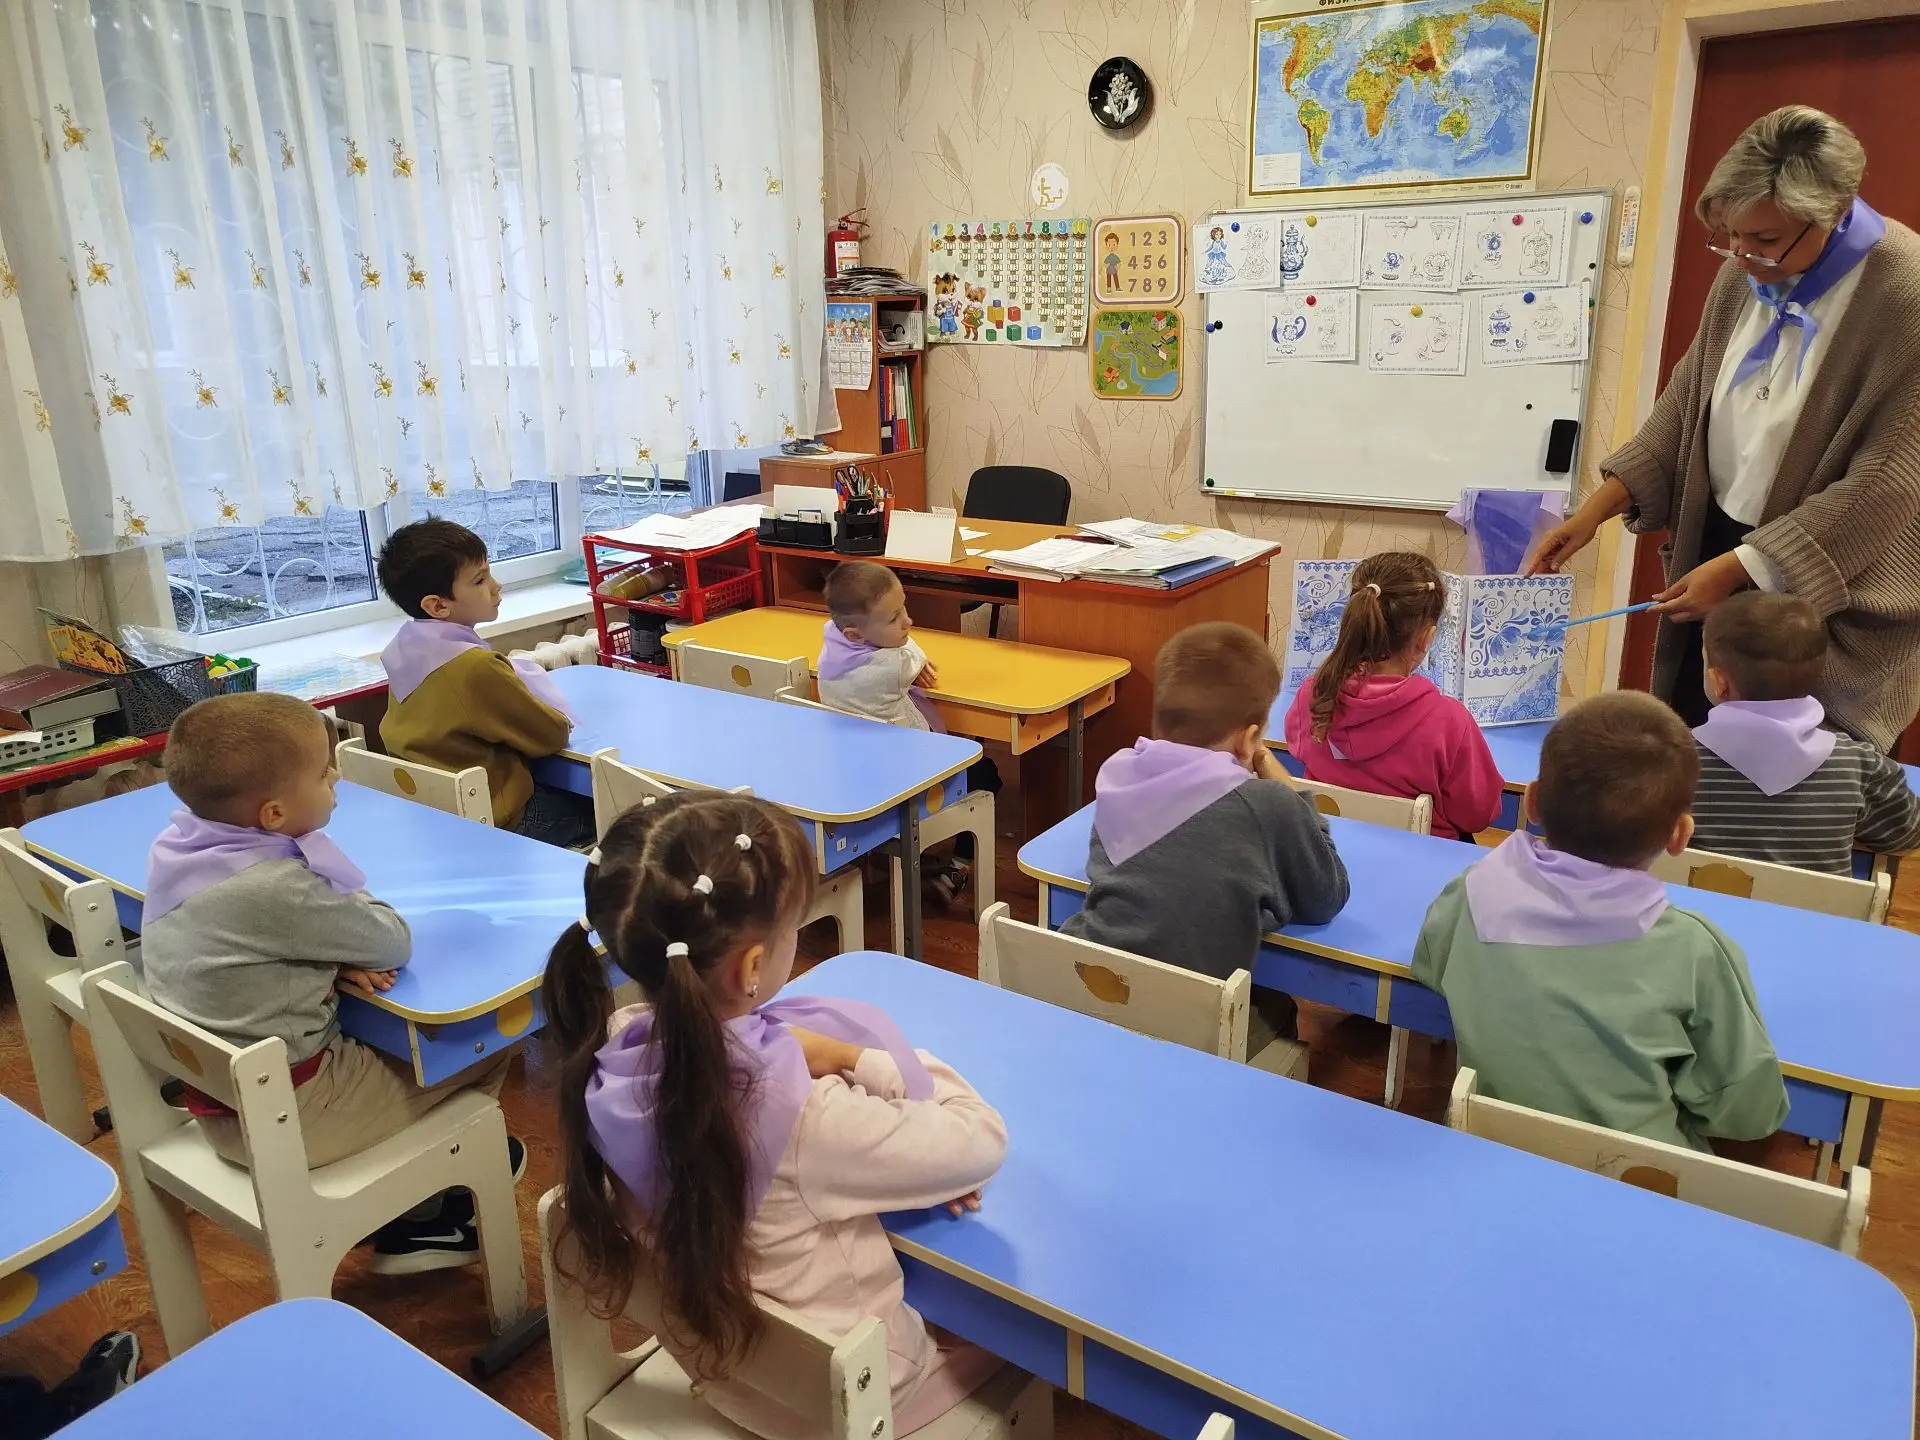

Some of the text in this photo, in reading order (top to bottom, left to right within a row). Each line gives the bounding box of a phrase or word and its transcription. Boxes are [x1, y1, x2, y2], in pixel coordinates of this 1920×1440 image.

[932, 219, 1088, 236] 1 2 3 4 5 6 7 8 9 10
[1130, 231, 1167, 246] 1 2 3
[1128, 254, 1167, 269] 4 5 6
[1128, 278, 1167, 292] 7 8 9
